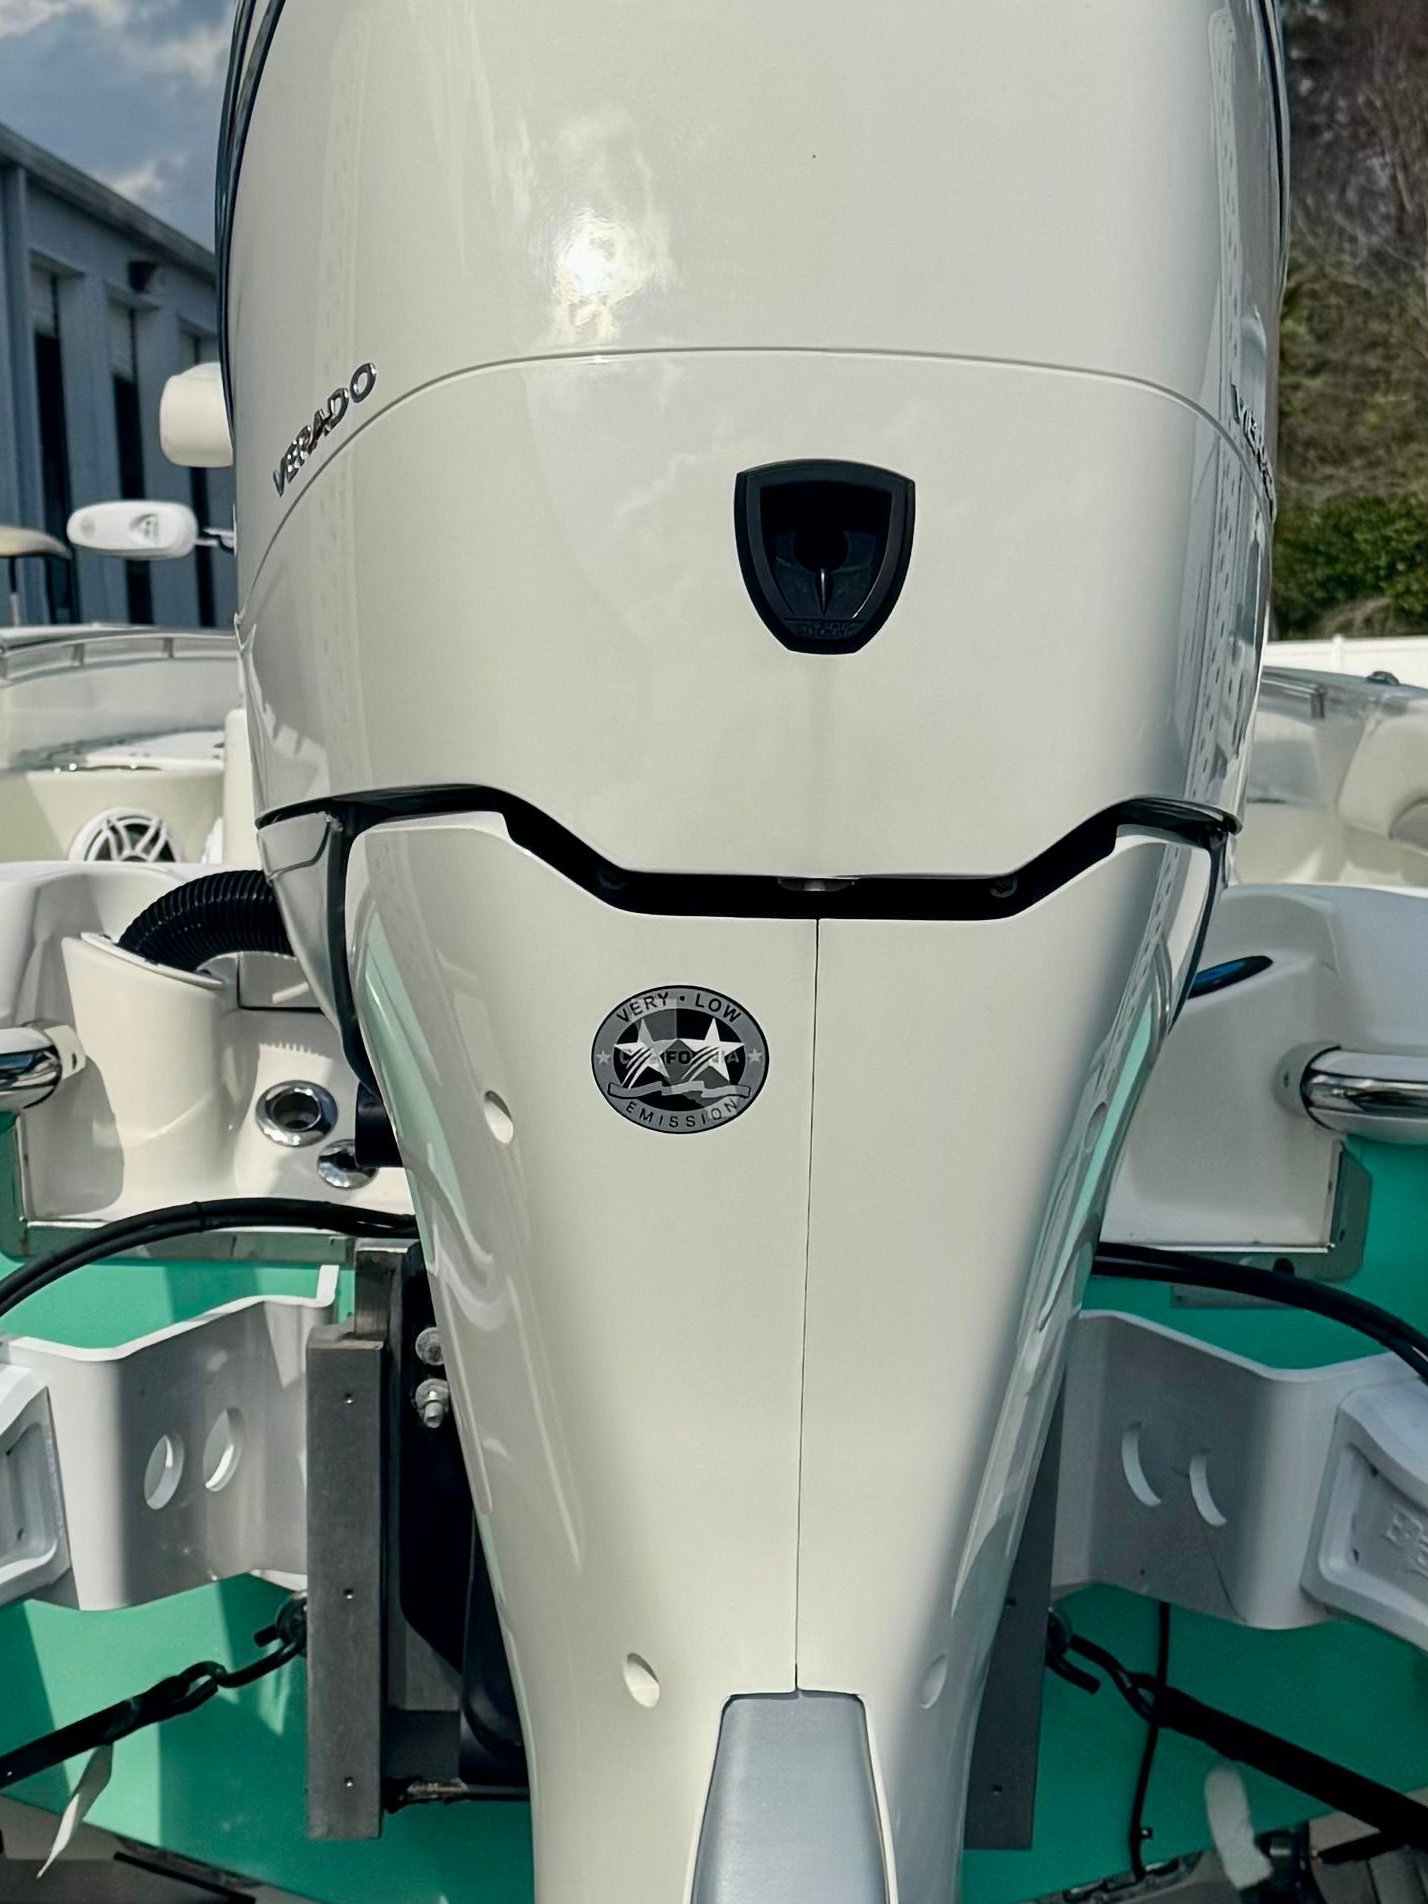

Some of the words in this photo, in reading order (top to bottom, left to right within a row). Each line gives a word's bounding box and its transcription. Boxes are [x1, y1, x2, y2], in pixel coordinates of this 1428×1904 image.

[616, 992, 669, 1023] VERY
[695, 993, 742, 1024] LOW
[626, 1099, 737, 1128] EMISSION
